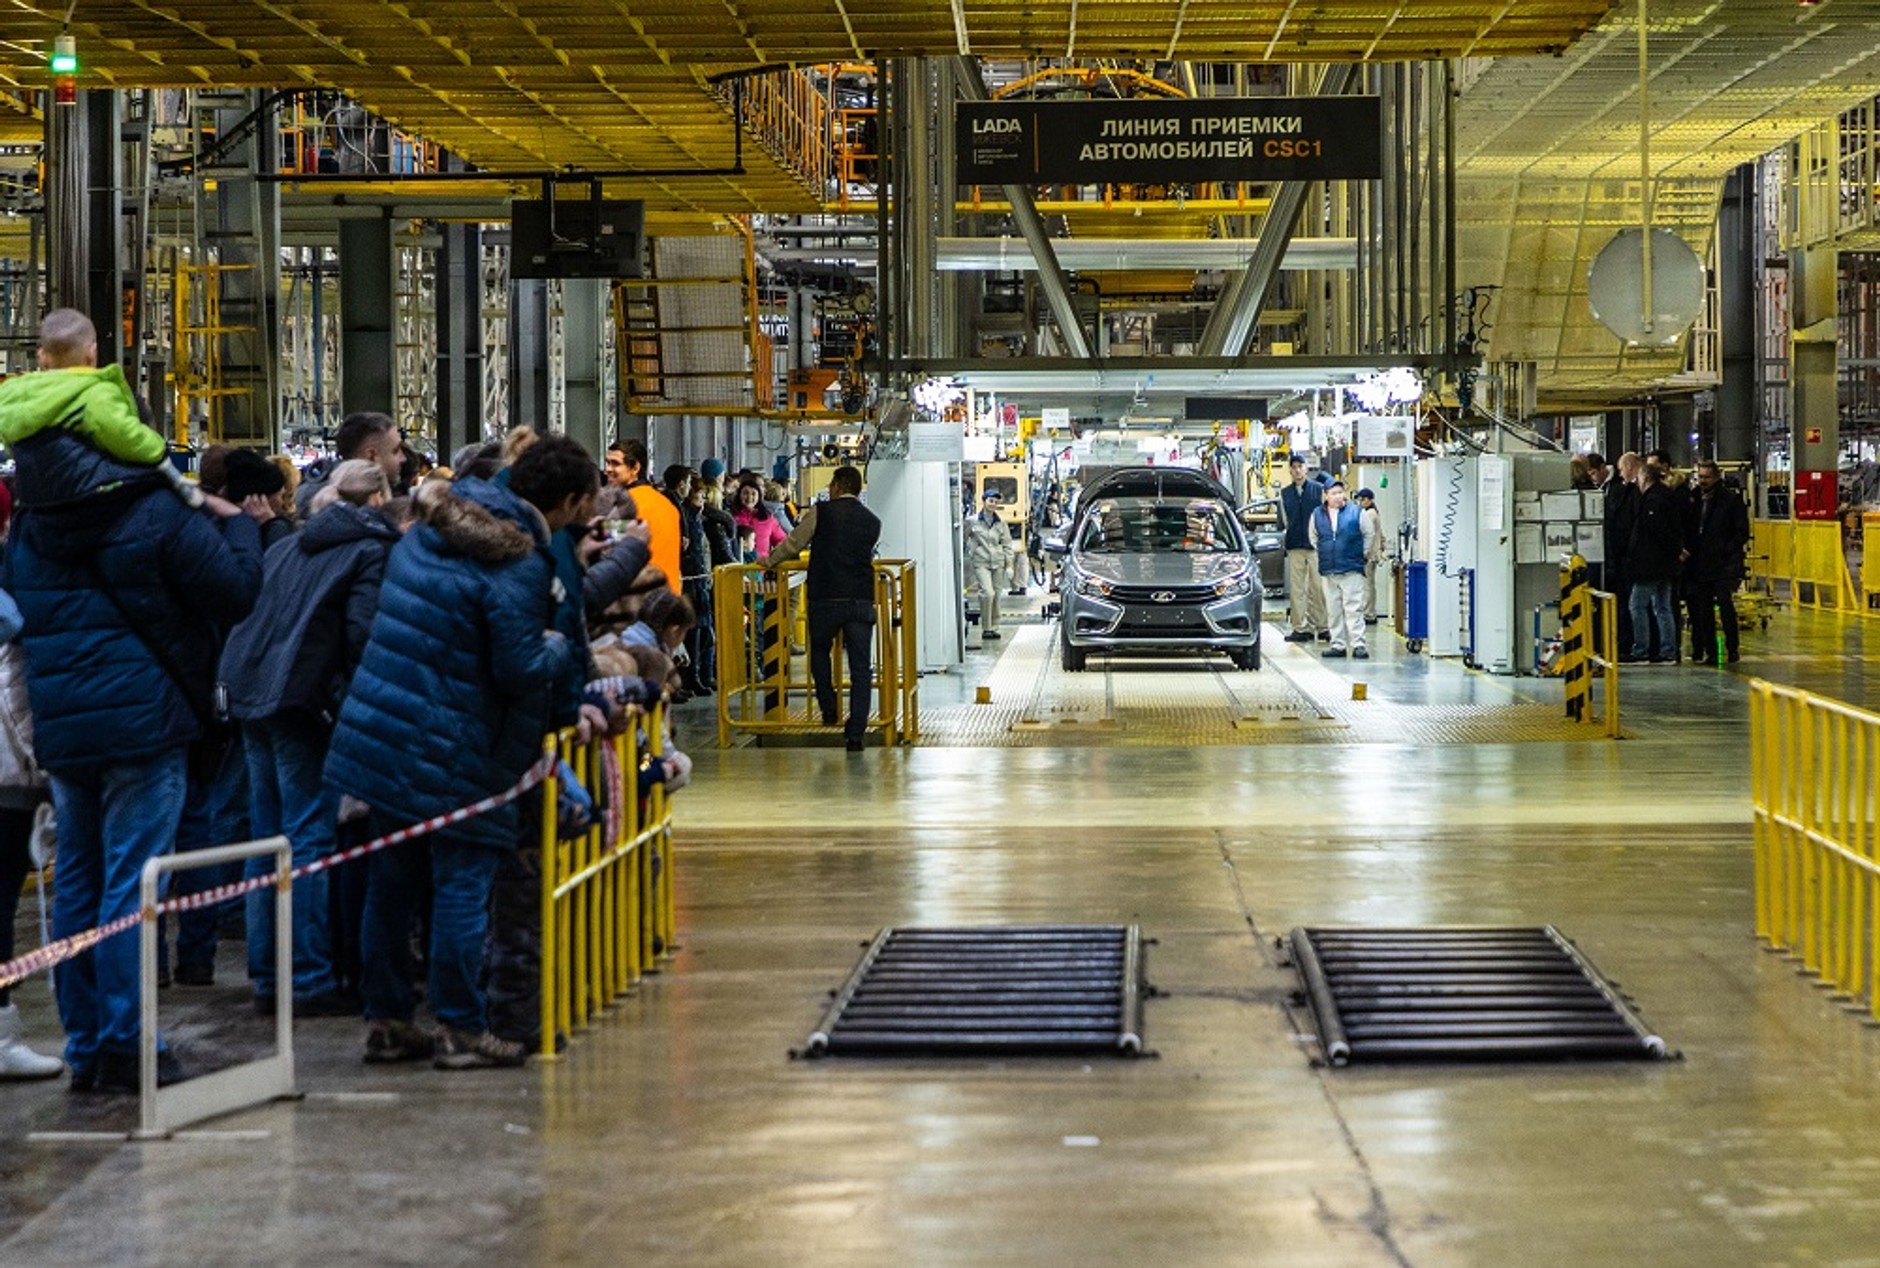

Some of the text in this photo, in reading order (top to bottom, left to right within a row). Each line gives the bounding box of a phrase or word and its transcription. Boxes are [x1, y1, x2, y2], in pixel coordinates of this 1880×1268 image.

[973, 118, 1022, 133] LADA
[1100, 116, 1302, 137] ЛИНИЯ ПРИЕМКИ
[1079, 137, 1322, 161] АВТОМОБИЛЕЙ CSC1
